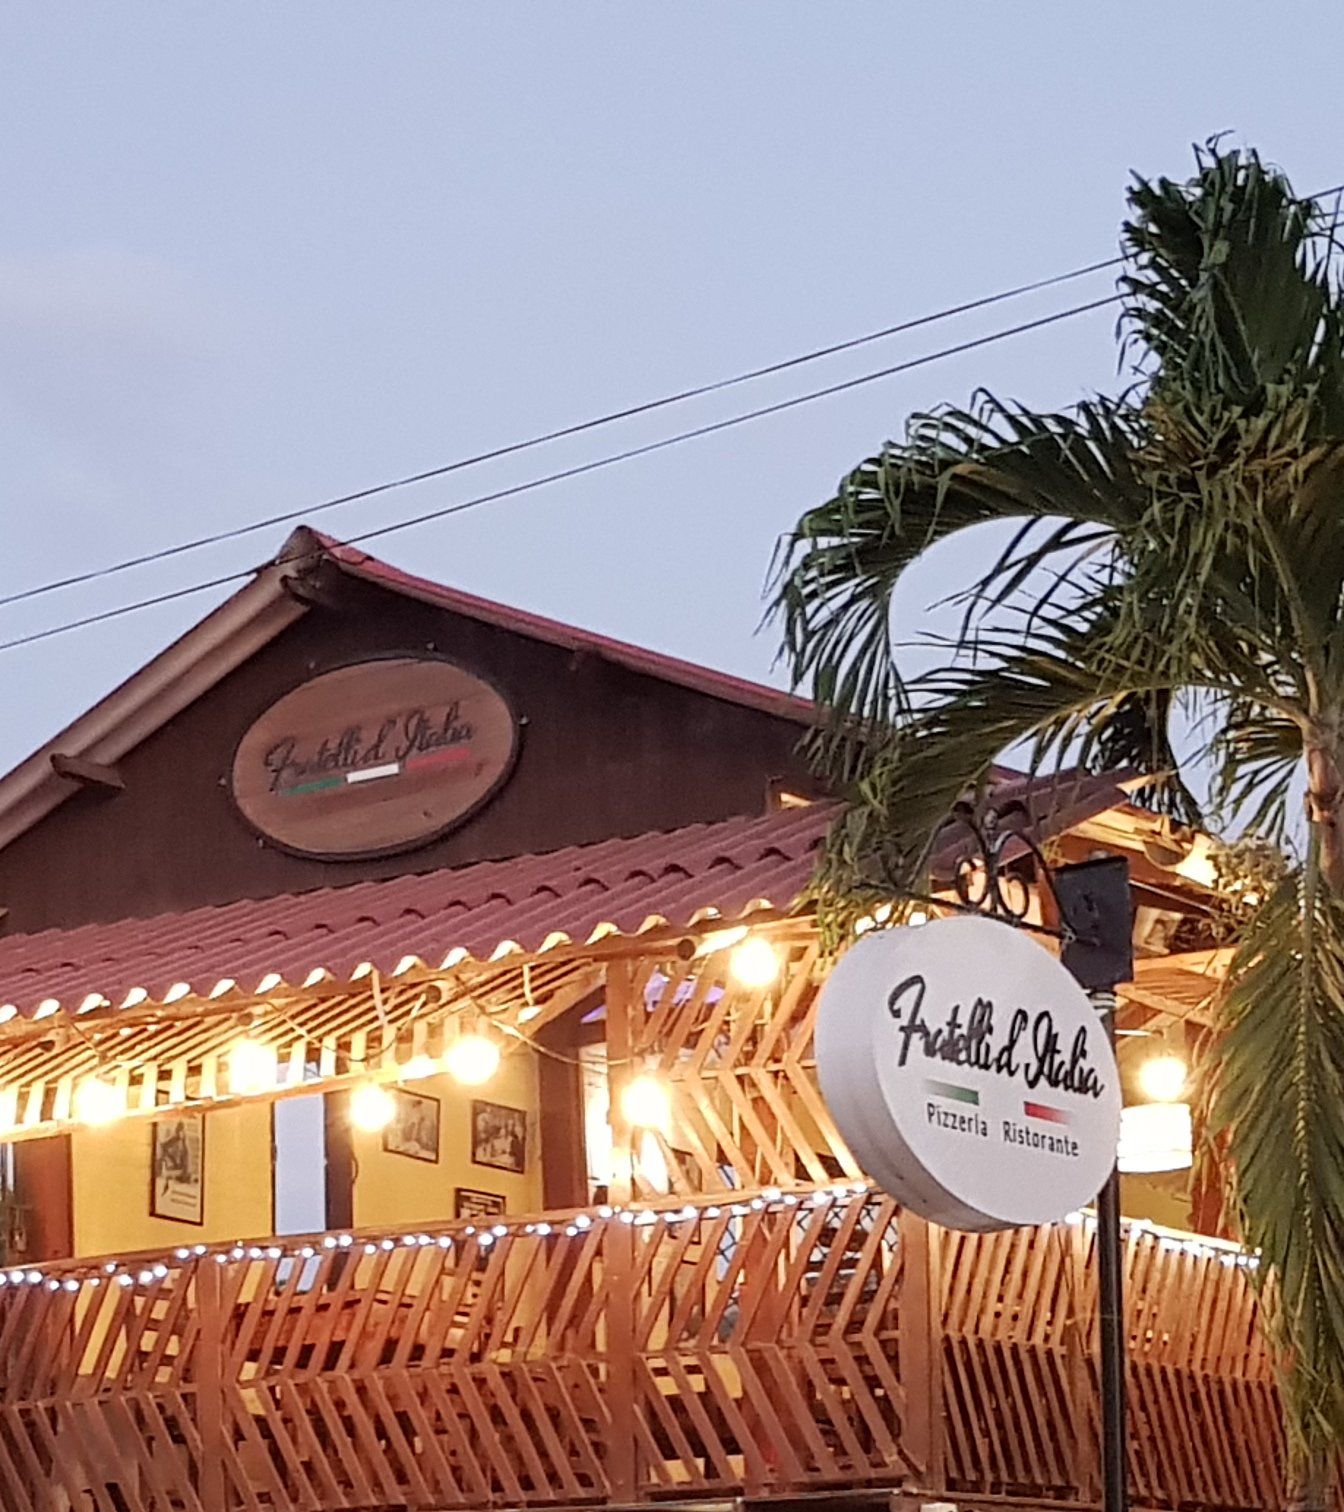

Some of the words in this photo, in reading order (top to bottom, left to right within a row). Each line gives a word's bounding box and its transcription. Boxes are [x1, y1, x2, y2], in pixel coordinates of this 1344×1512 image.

[887, 974, 995, 1072] Fratelli
[926, 1102, 988, 1138] Pizzeria
[1002, 1120, 1080, 1158] Ristorante
